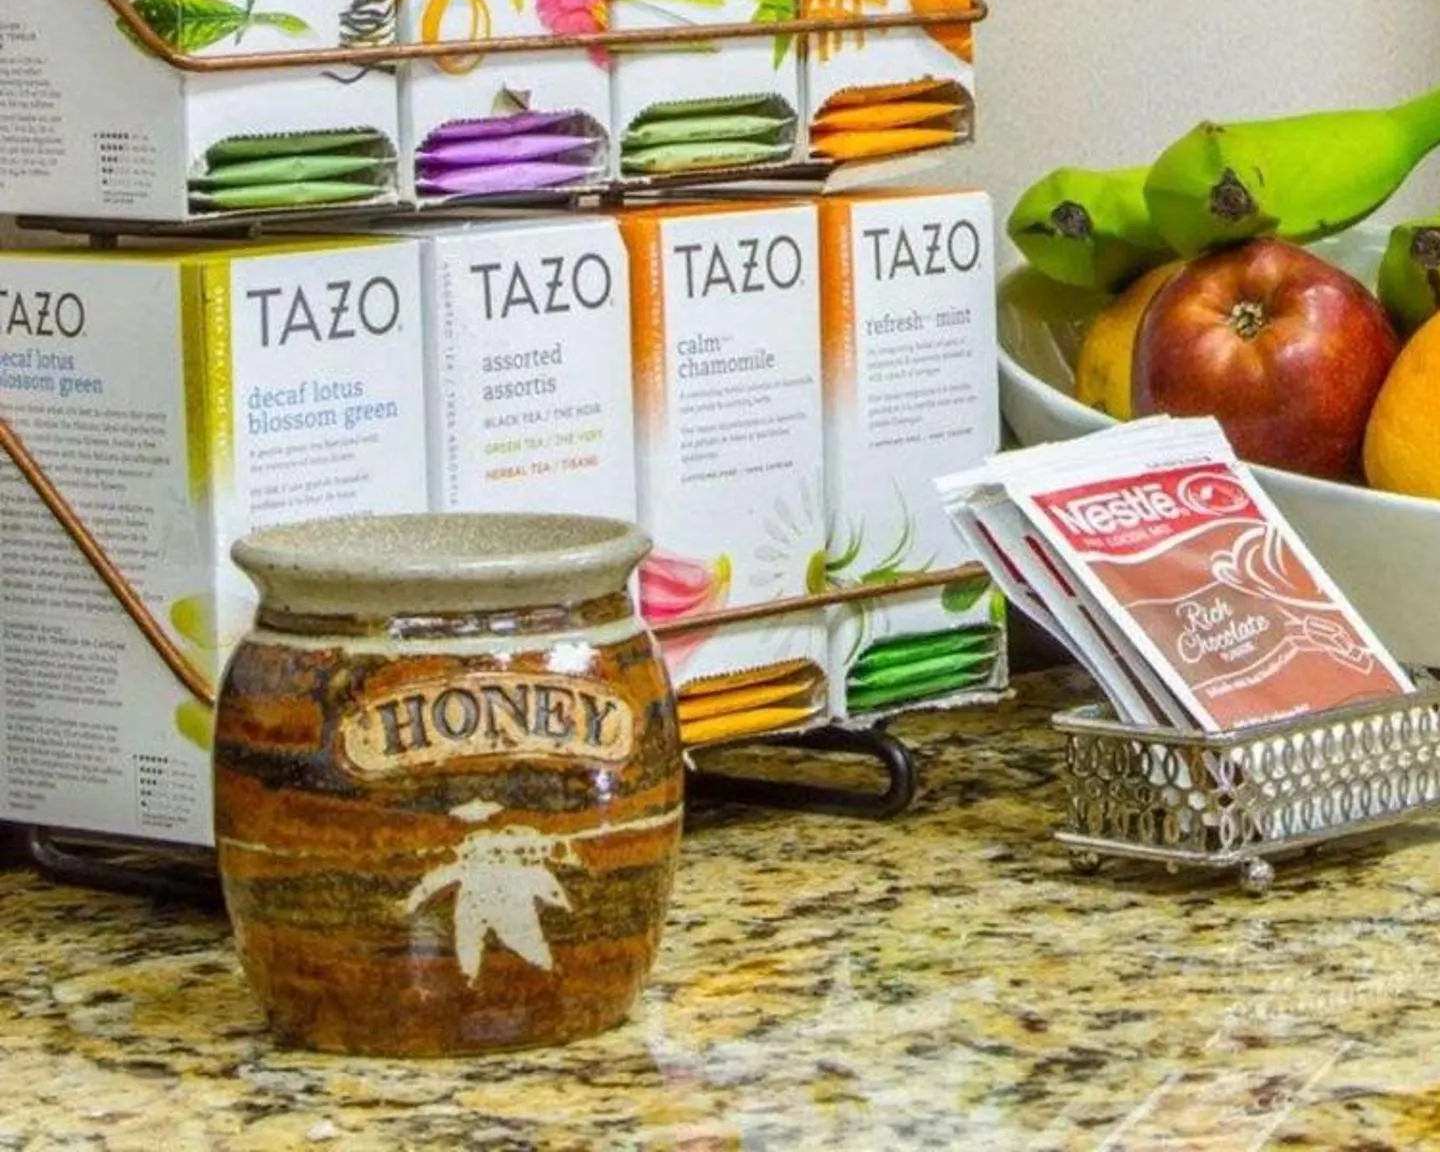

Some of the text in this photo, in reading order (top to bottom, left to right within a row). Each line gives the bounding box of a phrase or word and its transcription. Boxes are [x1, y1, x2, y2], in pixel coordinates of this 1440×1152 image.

[674, 235, 802, 298] TAZO
[864, 219, 980, 281] TAZO
[470, 253, 612, 320] TAZO
[246, 276, 400, 347] TAZO
[867, 306, 971, 336] refresh mint
[35, 347, 75, 370] lotus
[482, 342, 563, 373] assorted
[677, 334, 722, 357] calm
[678, 349, 775, 379] chamomile
[59, 375, 103, 397] green
[247, 377, 365, 411] decaf lotus
[482, 377, 557, 401] assortis
[248, 400, 399, 436] blossom green
[1176, 598, 1233, 633] Rich
[1177, 615, 1270, 664] Chocolate
[378, 684, 619, 755] HONEY
